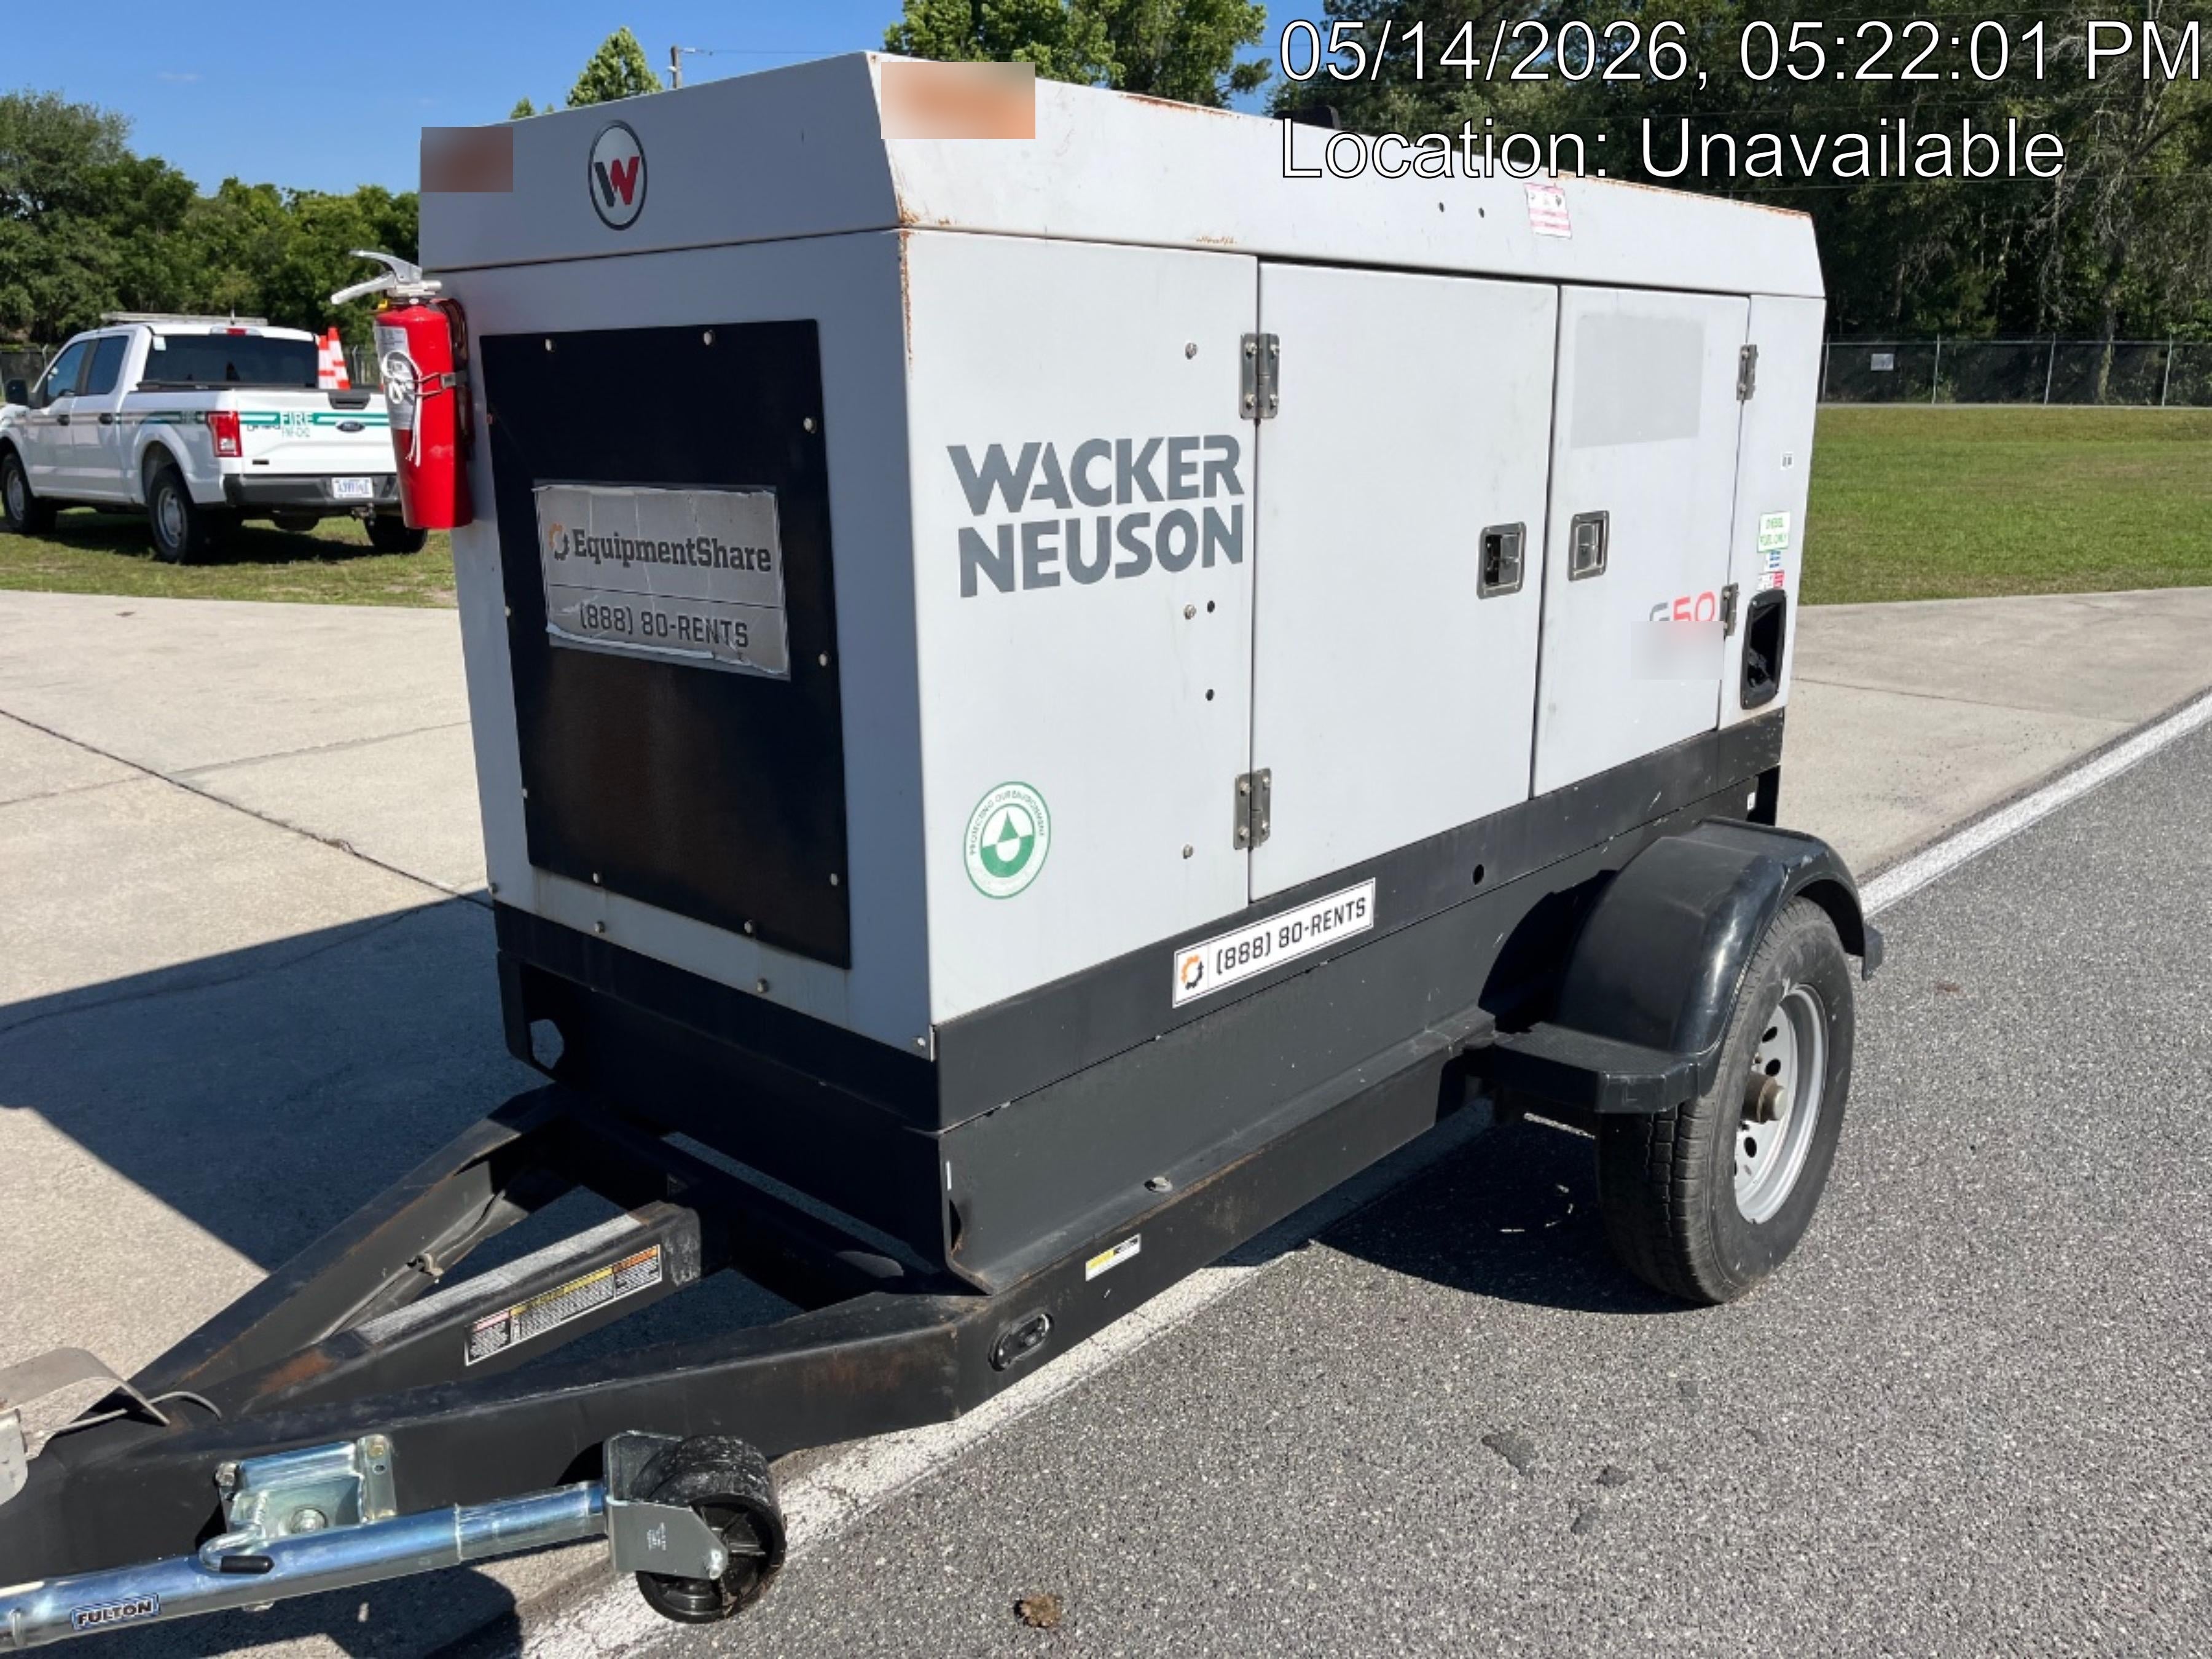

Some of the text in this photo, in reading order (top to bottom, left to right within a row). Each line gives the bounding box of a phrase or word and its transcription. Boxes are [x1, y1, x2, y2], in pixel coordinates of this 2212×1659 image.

[281, 412, 313, 425] FIRE
[946, 434, 1244, 517] WACKER
[572, 528, 771, 572] EquipmentShare
[958, 504, 1244, 598] NEUSON
[579, 602, 749, 648] (888) 80-RENTS
[1216, 896, 1367, 976] (888) 80-RENTS
[77, 1601, 152, 1625] FULTON
